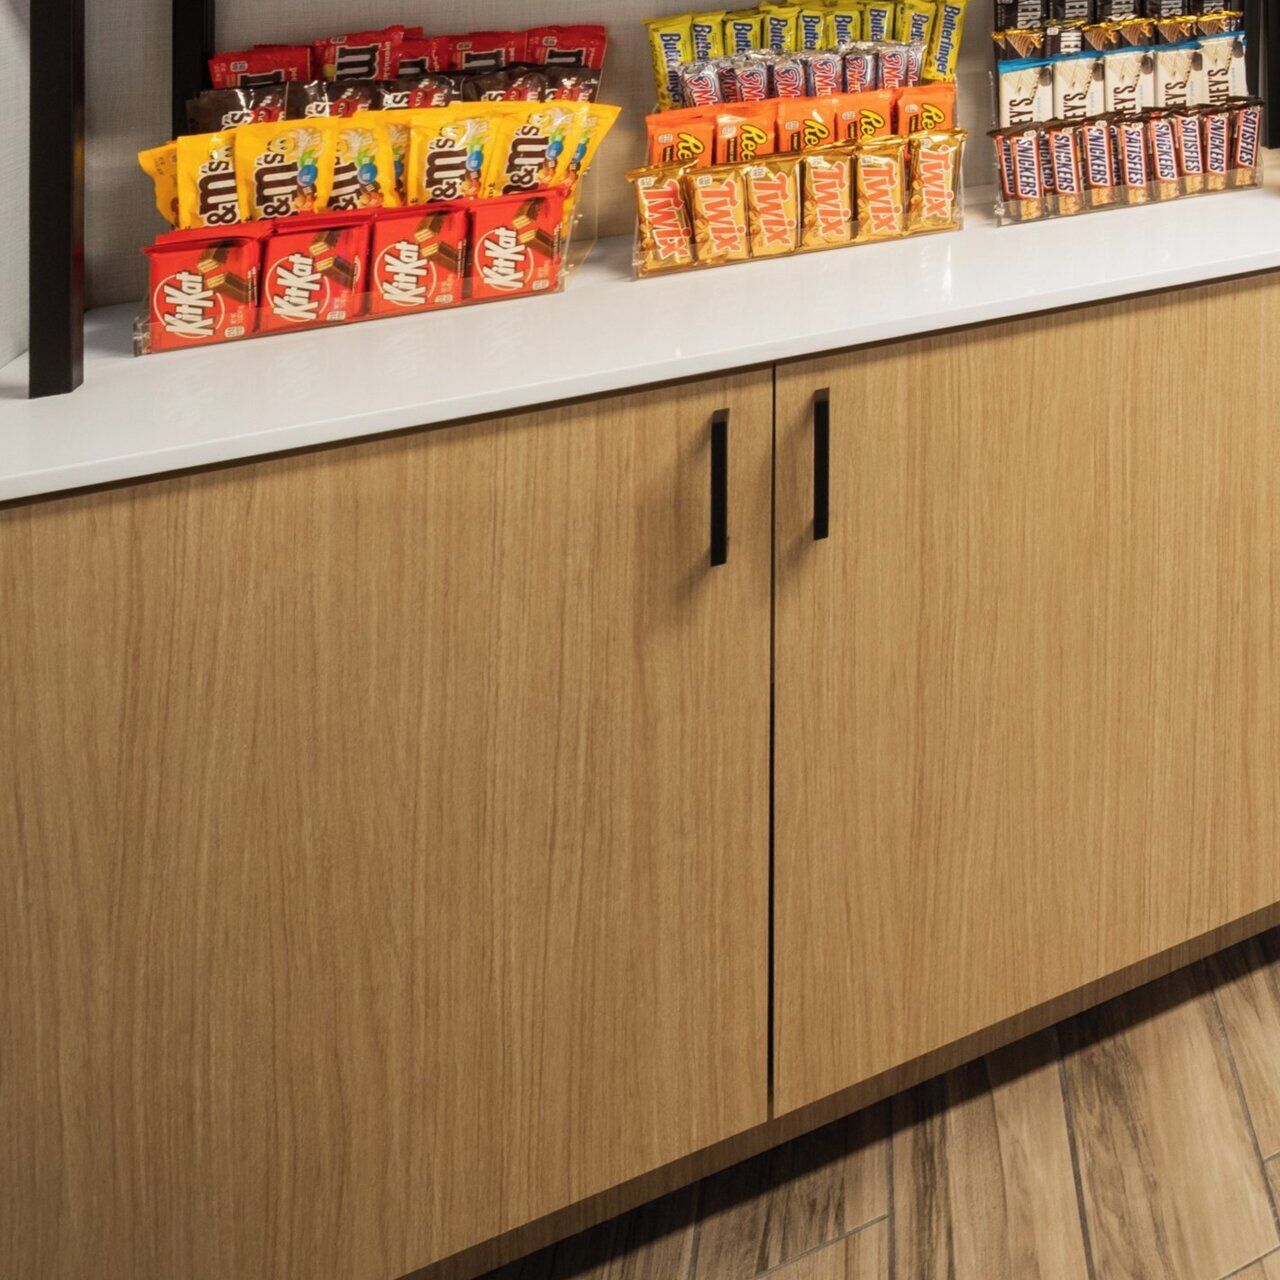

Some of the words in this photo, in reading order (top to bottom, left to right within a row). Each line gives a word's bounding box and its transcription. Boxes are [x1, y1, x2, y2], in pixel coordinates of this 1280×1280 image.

[933, 3, 962, 78] Butterfinger
[1016, 137, 1039, 199] SNICKERS
[1053, 134, 1076, 195] SNICKERS
[1087, 127, 1109, 187] SNICKERS
[1154, 122, 1176, 181] SNICKERS
[643, 179, 691, 261] Twix
[699, 177, 746, 256] Twix
[750, 172, 796, 247] Twix
[812, 160, 851, 238] Twix
